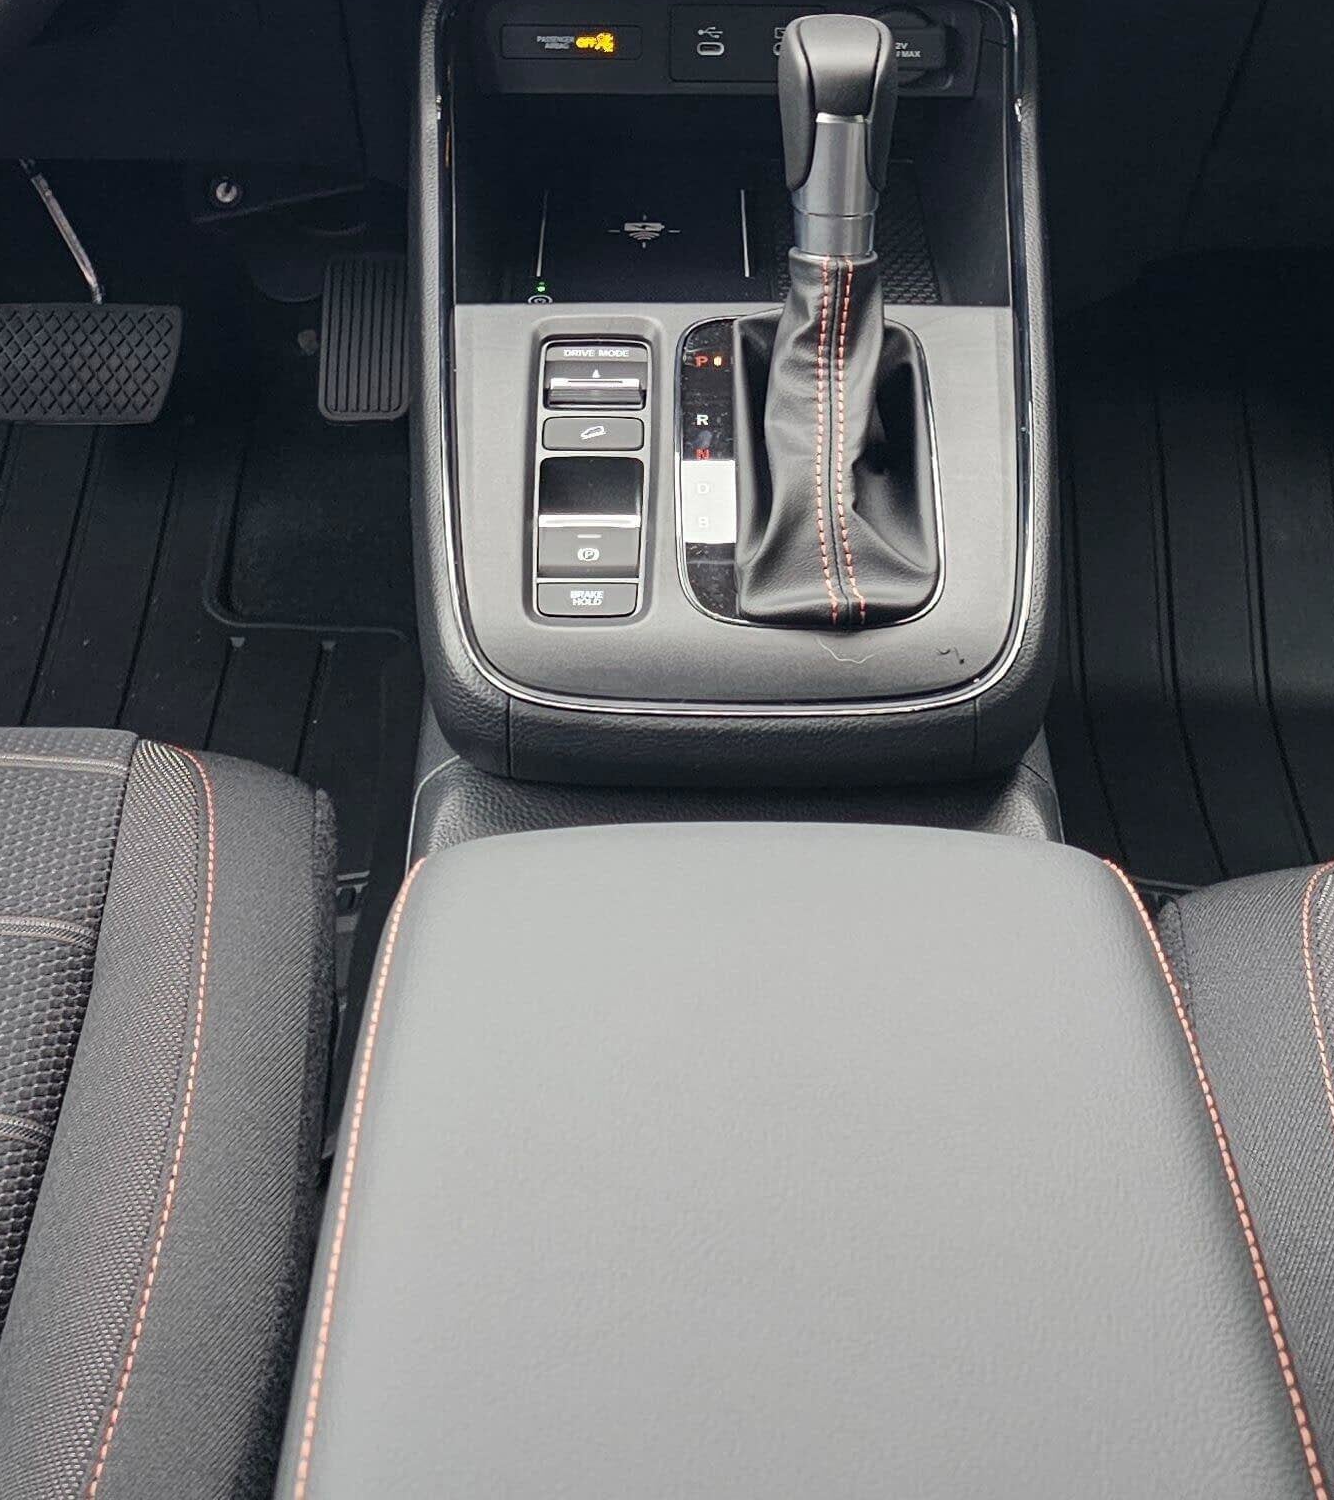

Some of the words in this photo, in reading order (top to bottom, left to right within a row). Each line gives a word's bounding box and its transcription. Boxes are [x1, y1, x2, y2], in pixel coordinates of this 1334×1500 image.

[901, 50, 921, 58] MAX
[563, 349, 595, 357] DRIVE
[598, 349, 629, 357] MODE
[695, 356, 708, 367] P
[696, 414, 709, 426] R
[696, 449, 710, 461] N
[697, 483, 710, 494] D
[570, 590, 604, 599] BRAKE
[572, 598, 603, 606] HOLD
